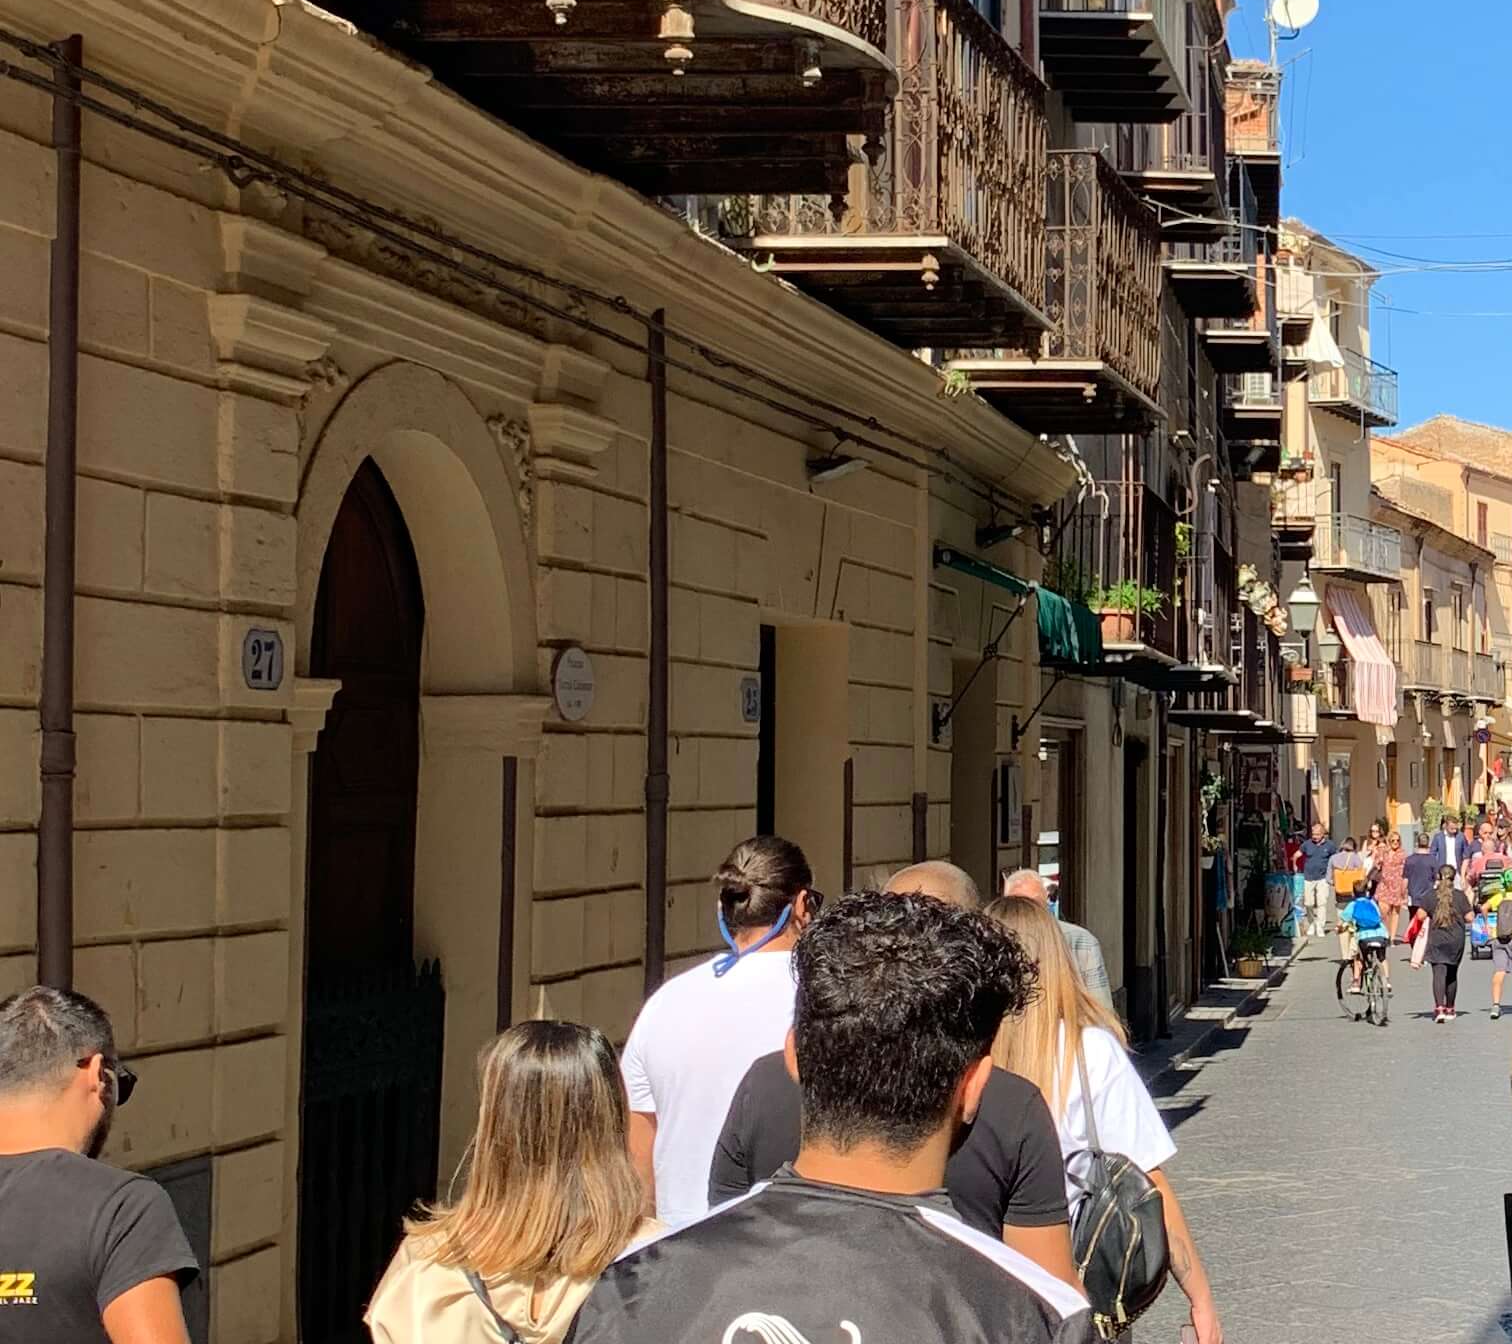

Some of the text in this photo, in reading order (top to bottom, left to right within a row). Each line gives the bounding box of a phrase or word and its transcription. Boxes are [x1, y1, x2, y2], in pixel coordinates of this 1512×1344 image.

[252, 639, 275, 681] 27
[0, 1272, 35, 1297] ZZ
[12, 1297, 39, 1305] JAZZ
